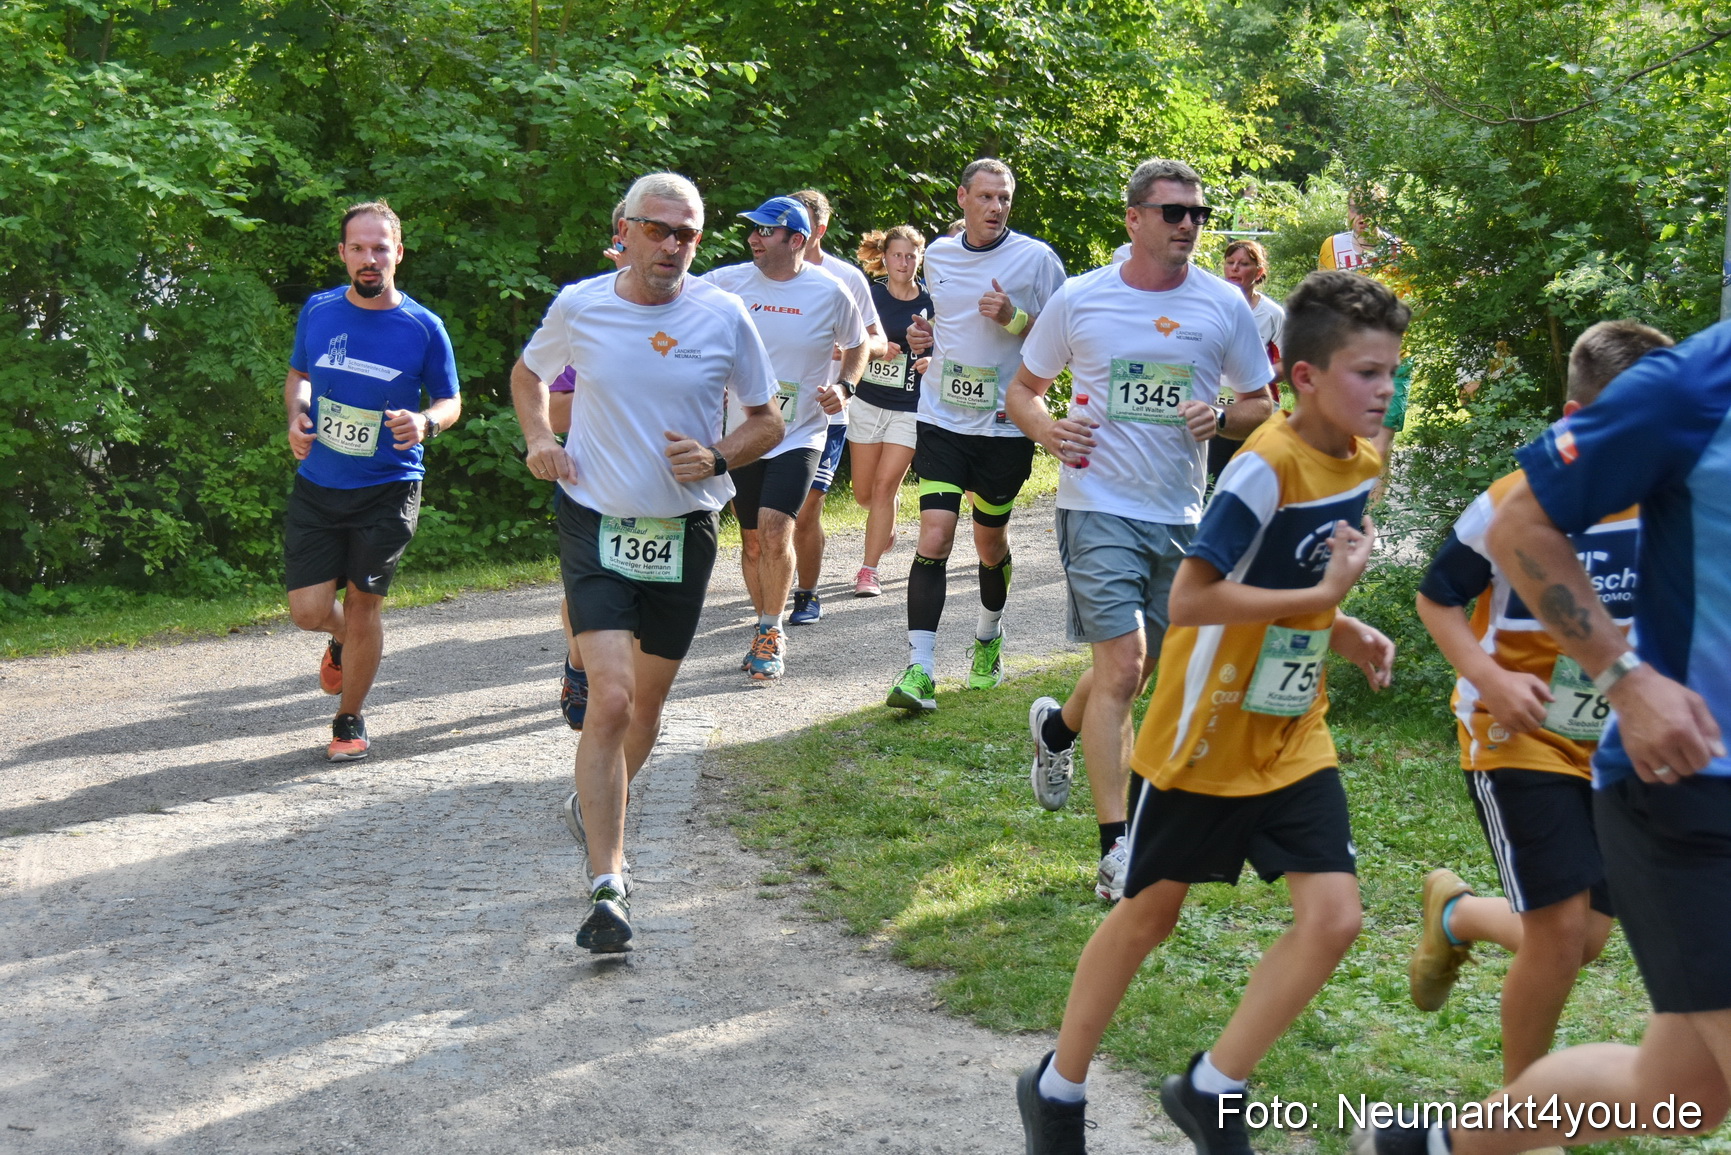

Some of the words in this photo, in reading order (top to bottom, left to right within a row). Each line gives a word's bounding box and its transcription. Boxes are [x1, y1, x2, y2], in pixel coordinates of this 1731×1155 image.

[763, 305, 803, 315] KLEBL
[868, 361, 900, 378] 1952
[951, 378, 984, 398] 694
[1119, 382, 1181, 408] 1345
[1145, 406, 1165, 414] Walter
[323, 416, 370, 444] 2136
[610, 534, 672, 563] 1364
[609, 556, 641, 569] Schweiger
[643, 562, 672, 571] Hermann
